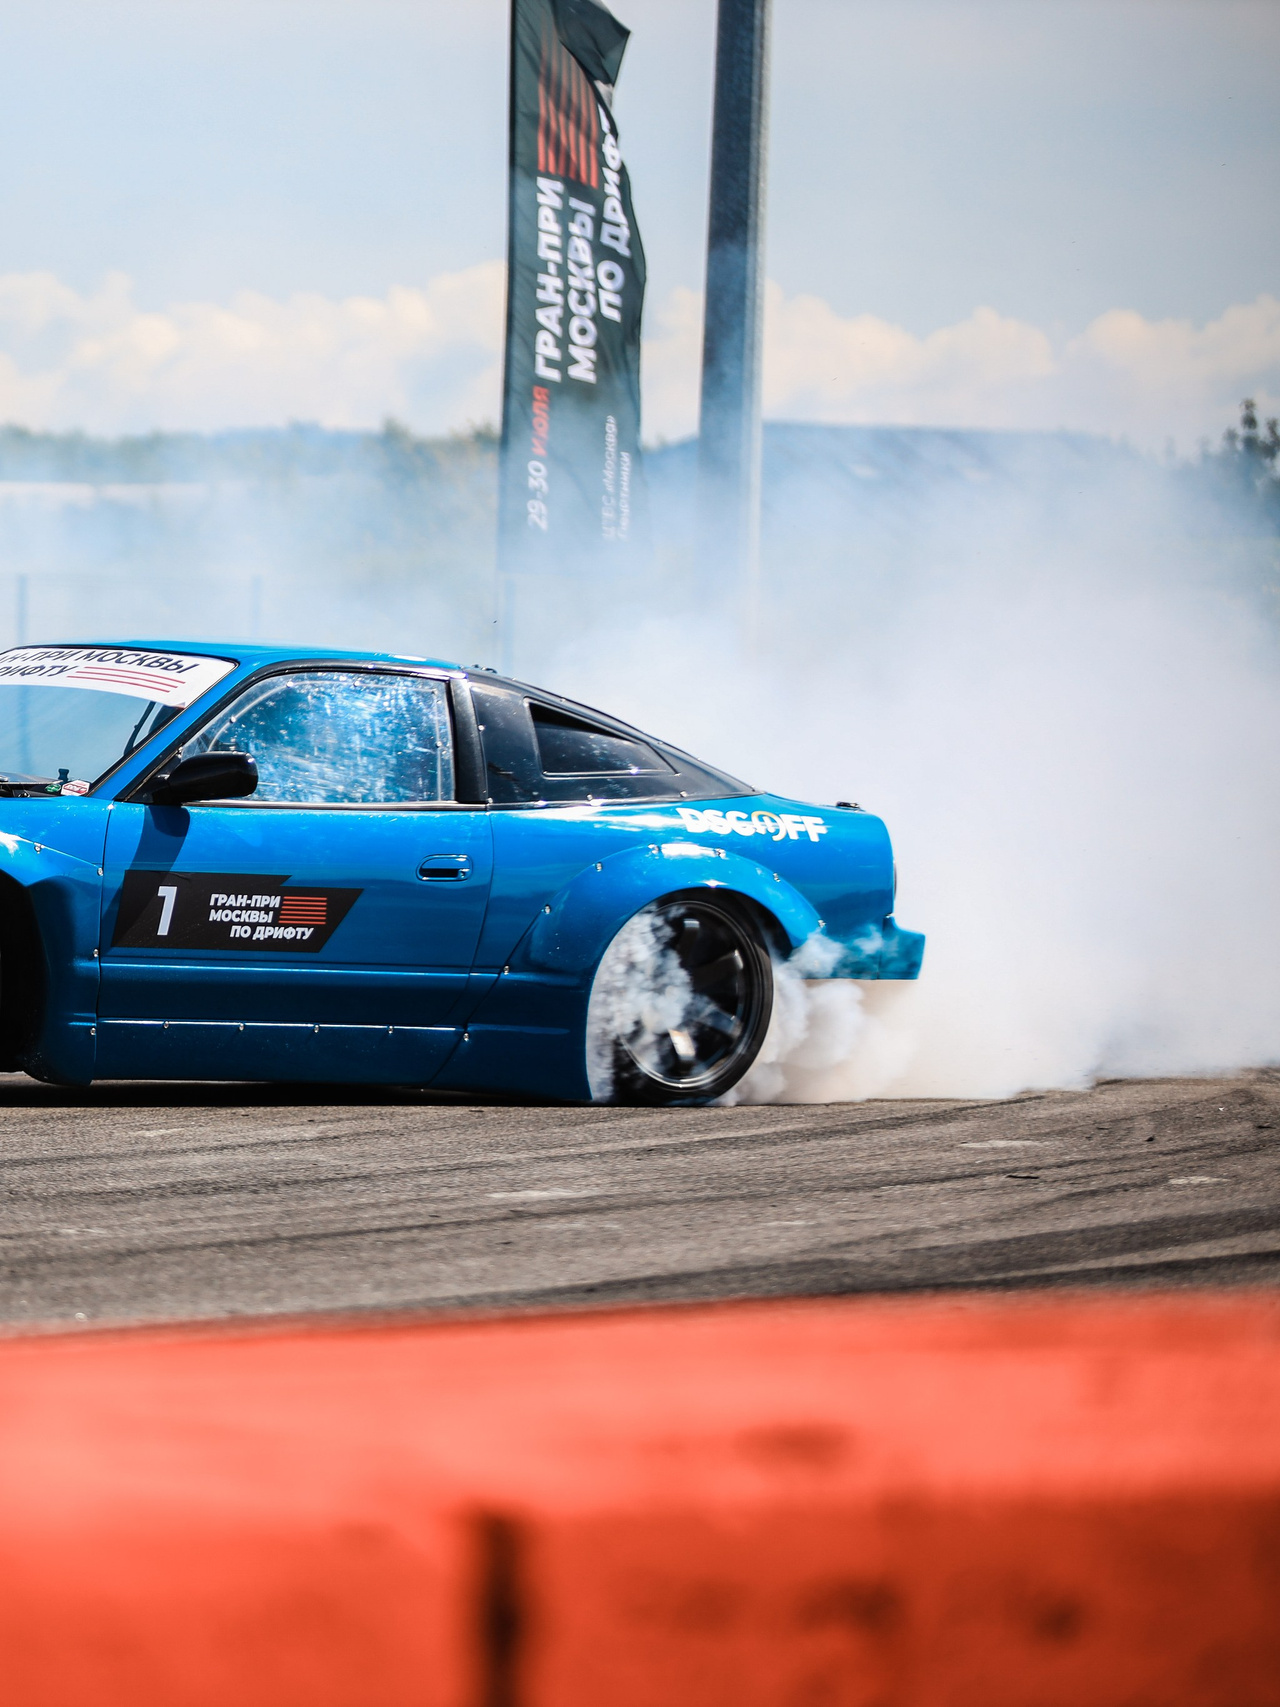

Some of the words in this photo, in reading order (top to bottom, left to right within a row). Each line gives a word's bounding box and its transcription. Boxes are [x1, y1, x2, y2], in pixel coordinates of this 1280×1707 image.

[598, 104, 632, 258] ДРИФ
[534, 176, 564, 383] ГРАН-ПРИ
[567, 196, 597, 384] МОСКВЫ
[597, 260, 625, 323] ПО
[526, 460, 549, 532] 29-30
[75, 650, 200, 674] МОСКВЫ
[157, 885, 178, 936] 1
[209, 893, 281, 908] ГРАН-ПРИ
[209, 909, 274, 923] МОСКВЫ
[229, 925, 252, 938] ПО
[252, 926, 314, 940] ДРИФТУ
